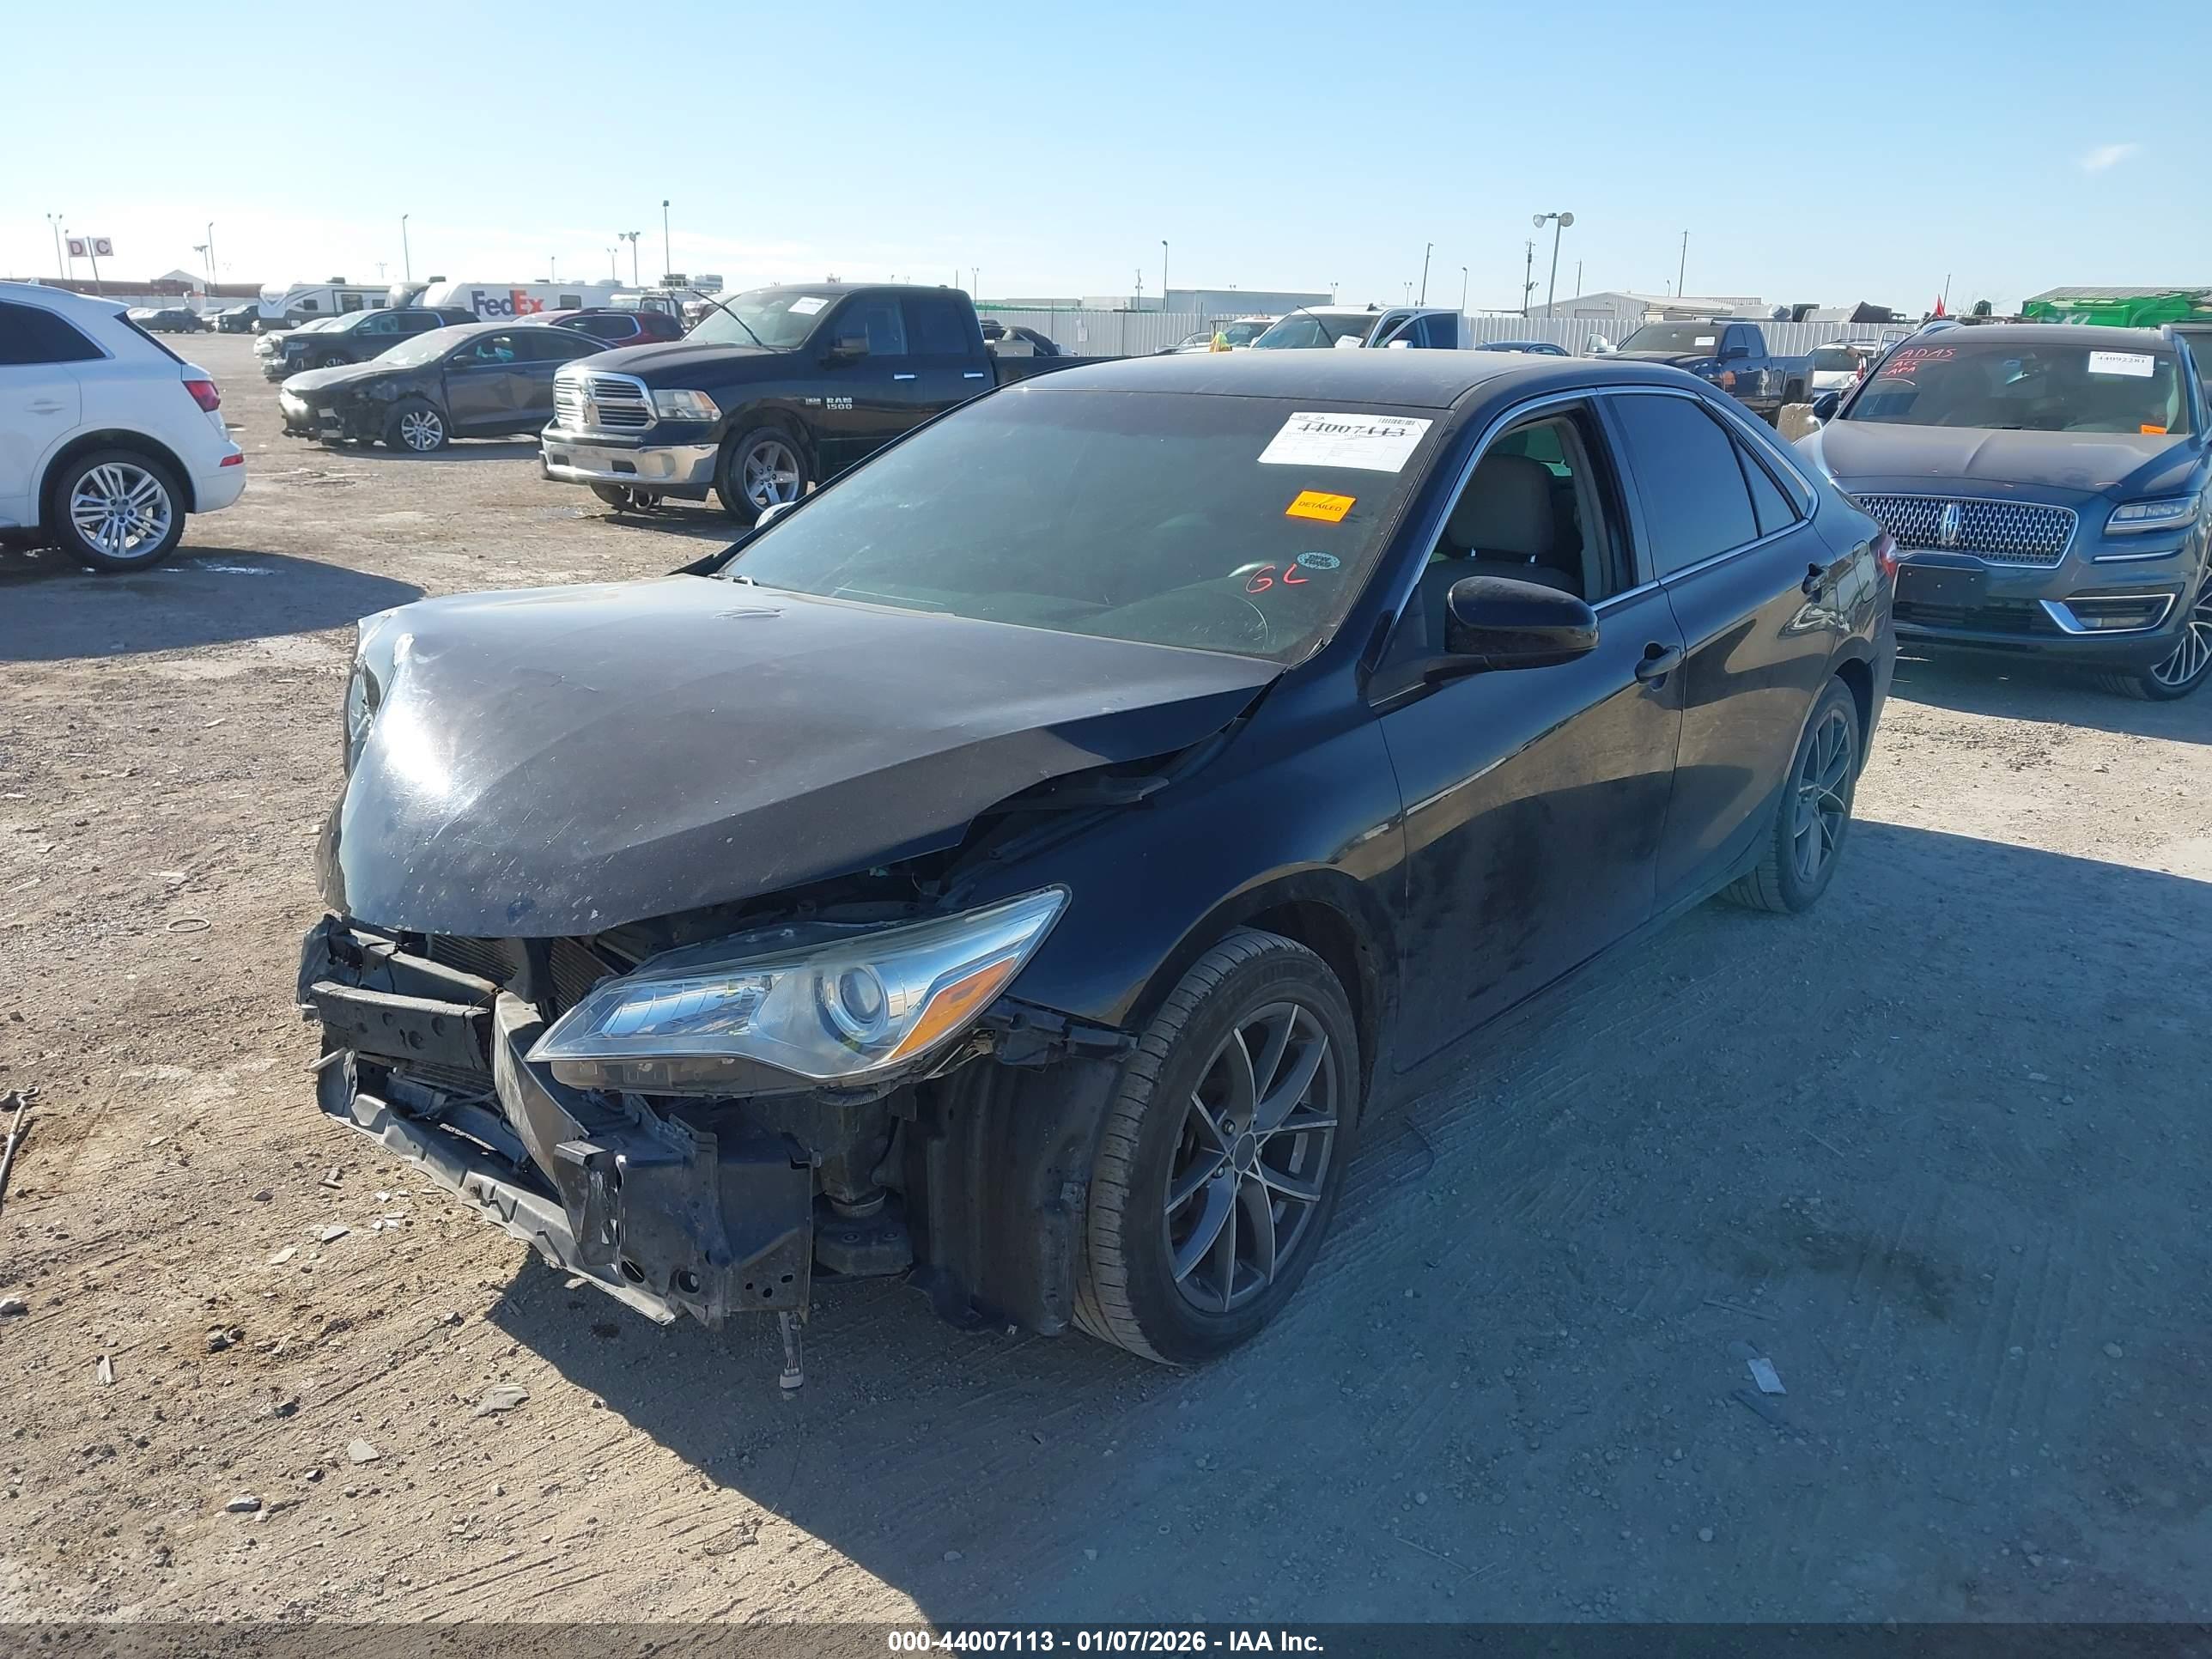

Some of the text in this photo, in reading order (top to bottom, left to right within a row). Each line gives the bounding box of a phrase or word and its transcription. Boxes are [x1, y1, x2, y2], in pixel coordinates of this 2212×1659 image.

[69, 241, 83, 255] D
[96, 240, 110, 254] C
[471, 289, 544, 317] FedEx
[1896, 348, 1958, 359] ADAS
[1297, 501, 1342, 513] DETAILED
